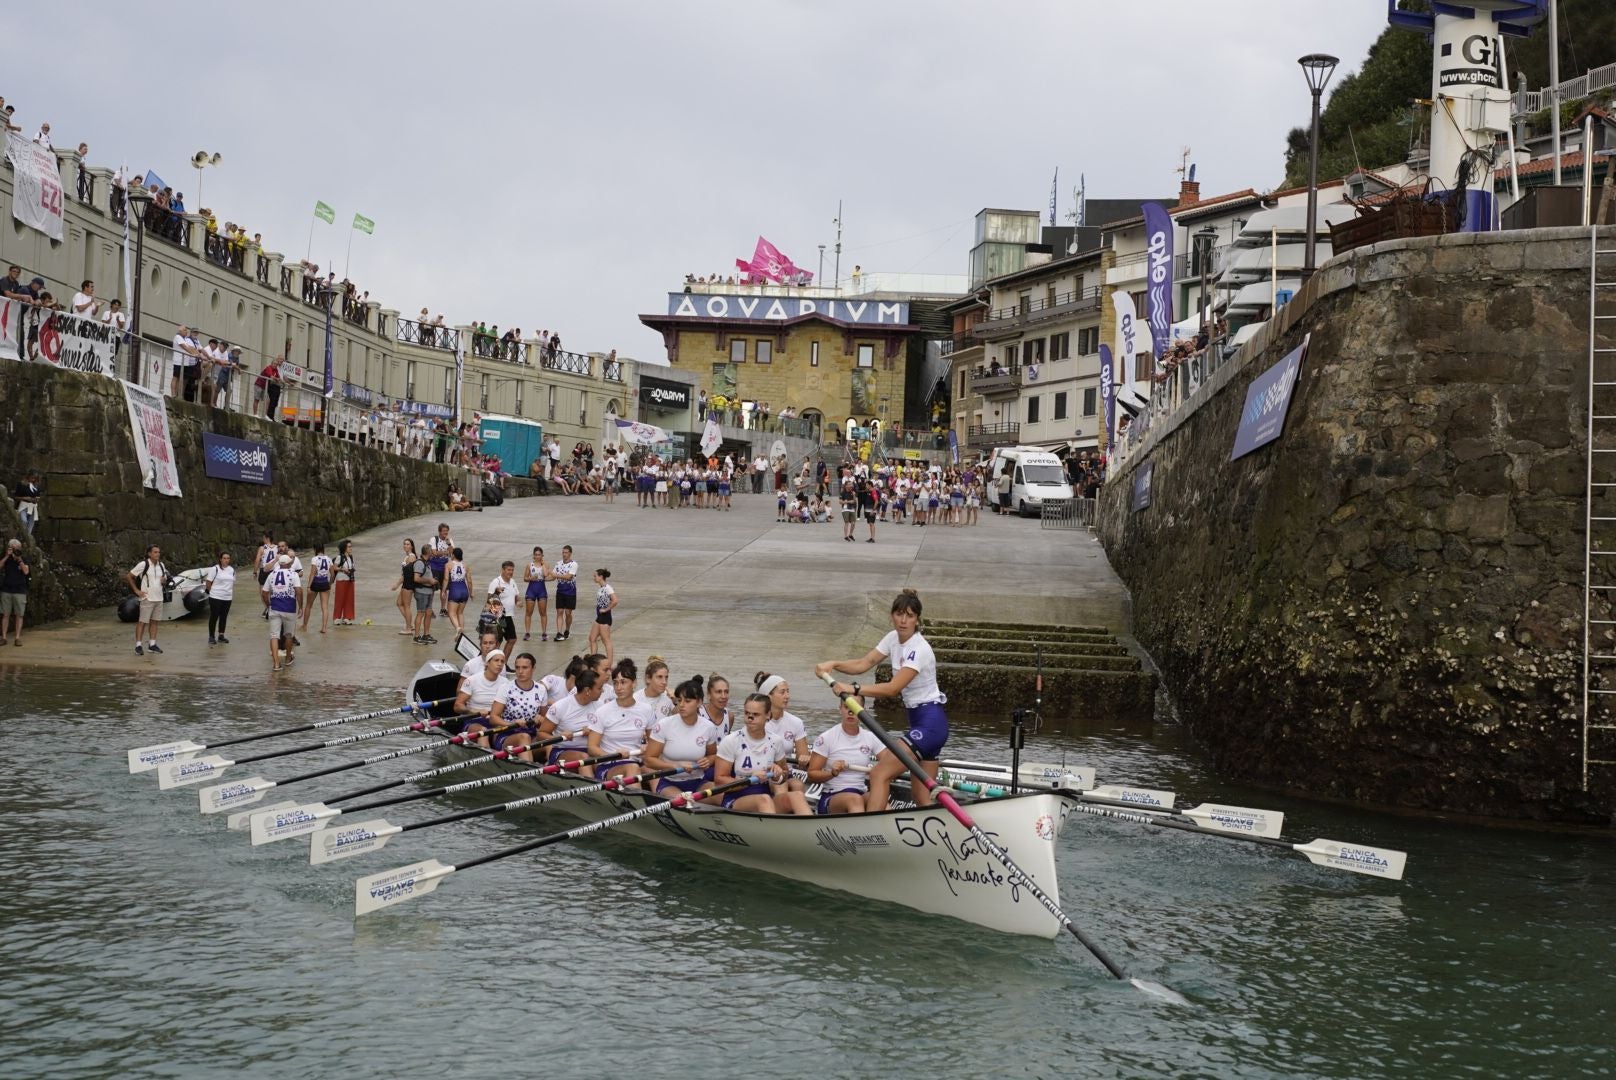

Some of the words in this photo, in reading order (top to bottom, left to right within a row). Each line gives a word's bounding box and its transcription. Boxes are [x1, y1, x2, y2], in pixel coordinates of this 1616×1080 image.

[253, 446, 268, 472] ekp
[320, 559, 329, 571] A
[275, 571, 286, 586] A
[907, 651, 916, 661] A
[742, 756, 752, 768] A
[221, 784, 245, 794] CLINICA
[222, 787, 256, 800] BAVIERA
[1122, 791, 1151, 799] CLINICA
[1121, 795, 1161, 806] BAVIERA
[276, 810, 304, 820] CLINICA
[277, 814, 317, 828] BAVIERA
[1106, 811, 1153, 824] LAGUNAK
[1210, 815, 1254, 826] BAVIERA
[1221, 822, 1252, 831] CLINICA
[336, 831, 377, 846] BAVIERA
[337, 828, 366, 838] CLINICA
[1341, 847, 1376, 857] CLINICA
[1340, 853, 1388, 867] BAVIERA
[971, 826, 1006, 863] DONOSTIA
[1005, 861, 1036, 892] ARRAUN
[1033, 889, 1072, 926] LAGUNAK
[370, 879, 415, 898] BAVIERA
[383, 887, 413, 901] CLINICA
